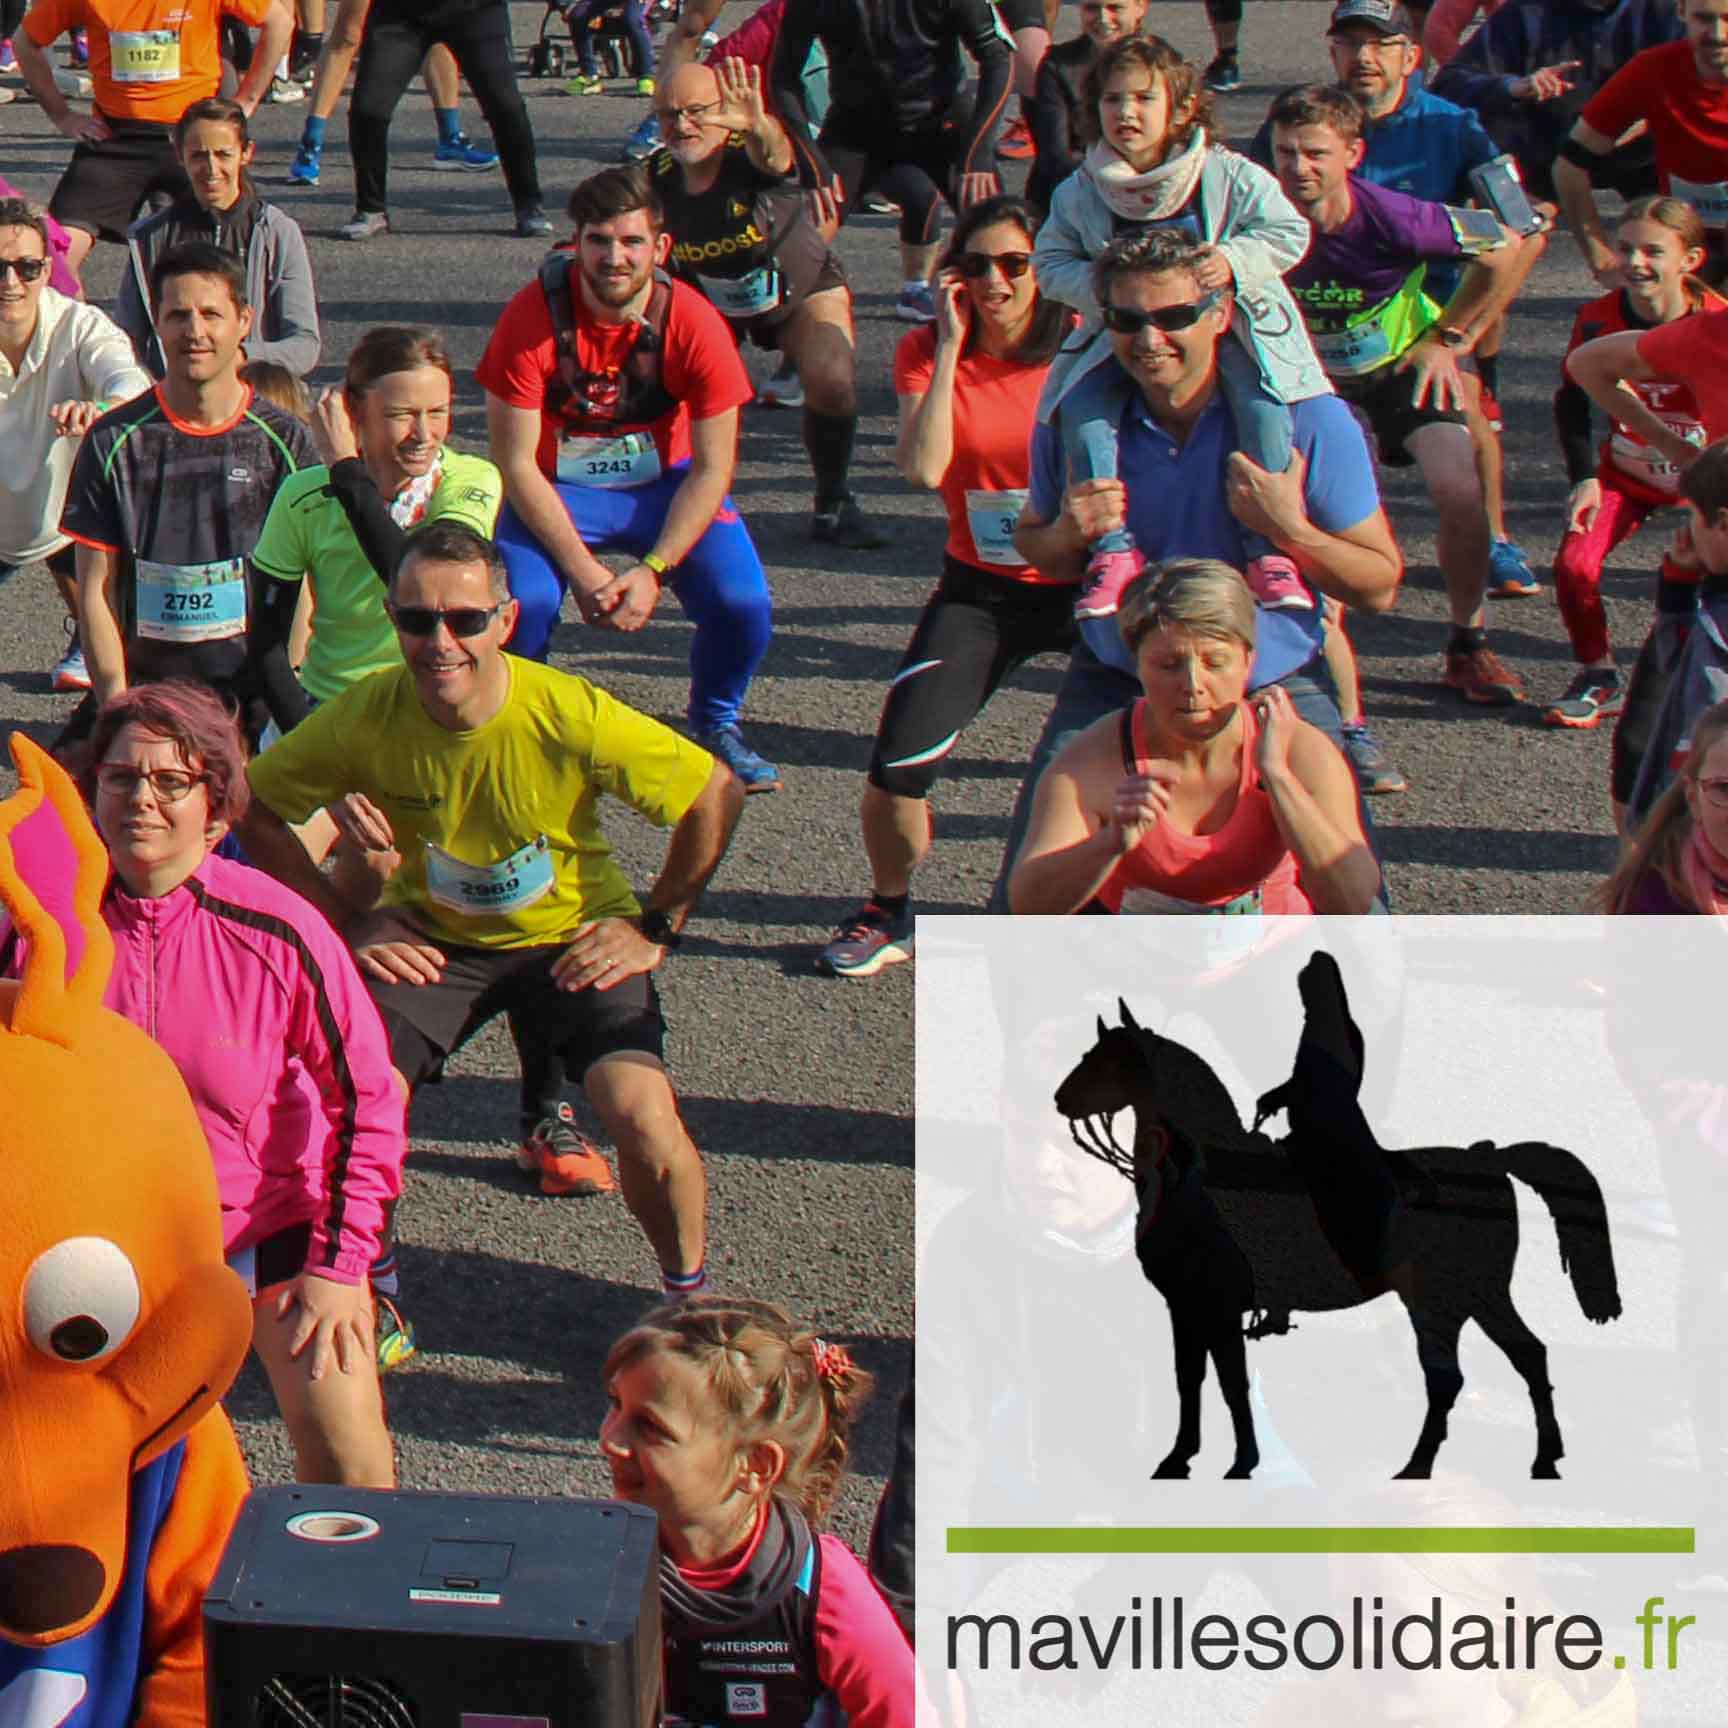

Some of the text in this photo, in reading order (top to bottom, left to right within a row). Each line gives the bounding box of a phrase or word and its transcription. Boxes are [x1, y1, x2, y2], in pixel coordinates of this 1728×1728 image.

[128, 49, 161, 63] 1182
[586, 459, 631, 474] 3243
[163, 591, 215, 611] 2792
